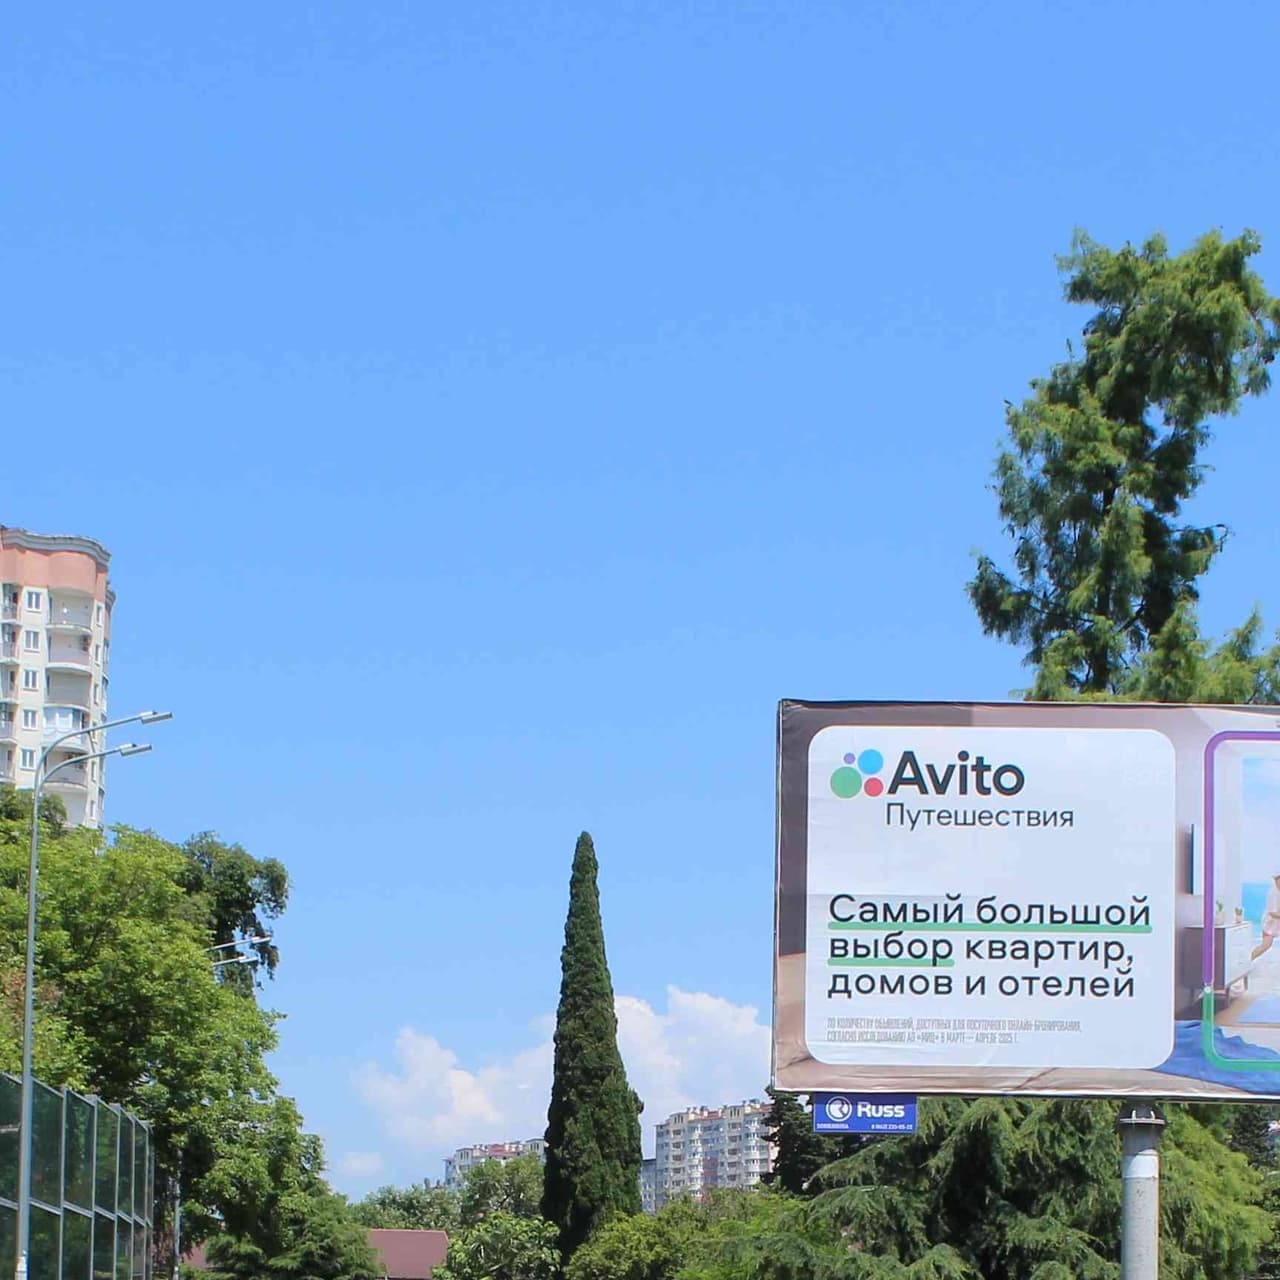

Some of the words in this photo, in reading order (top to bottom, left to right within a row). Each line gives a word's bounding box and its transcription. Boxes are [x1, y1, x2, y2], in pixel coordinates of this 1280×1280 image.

[887, 750, 1025, 796] Avito
[886, 803, 1074, 831] Путешествия
[829, 893, 964, 923] Самый
[976, 895, 1150, 926] большой
[829, 931, 953, 967] выбор
[966, 938, 1134, 969] квартир,
[827, 973, 953, 998] домов
[967, 975, 986, 996] и
[998, 967, 1135, 997] отелей
[857, 1101, 905, 1118] Russ
